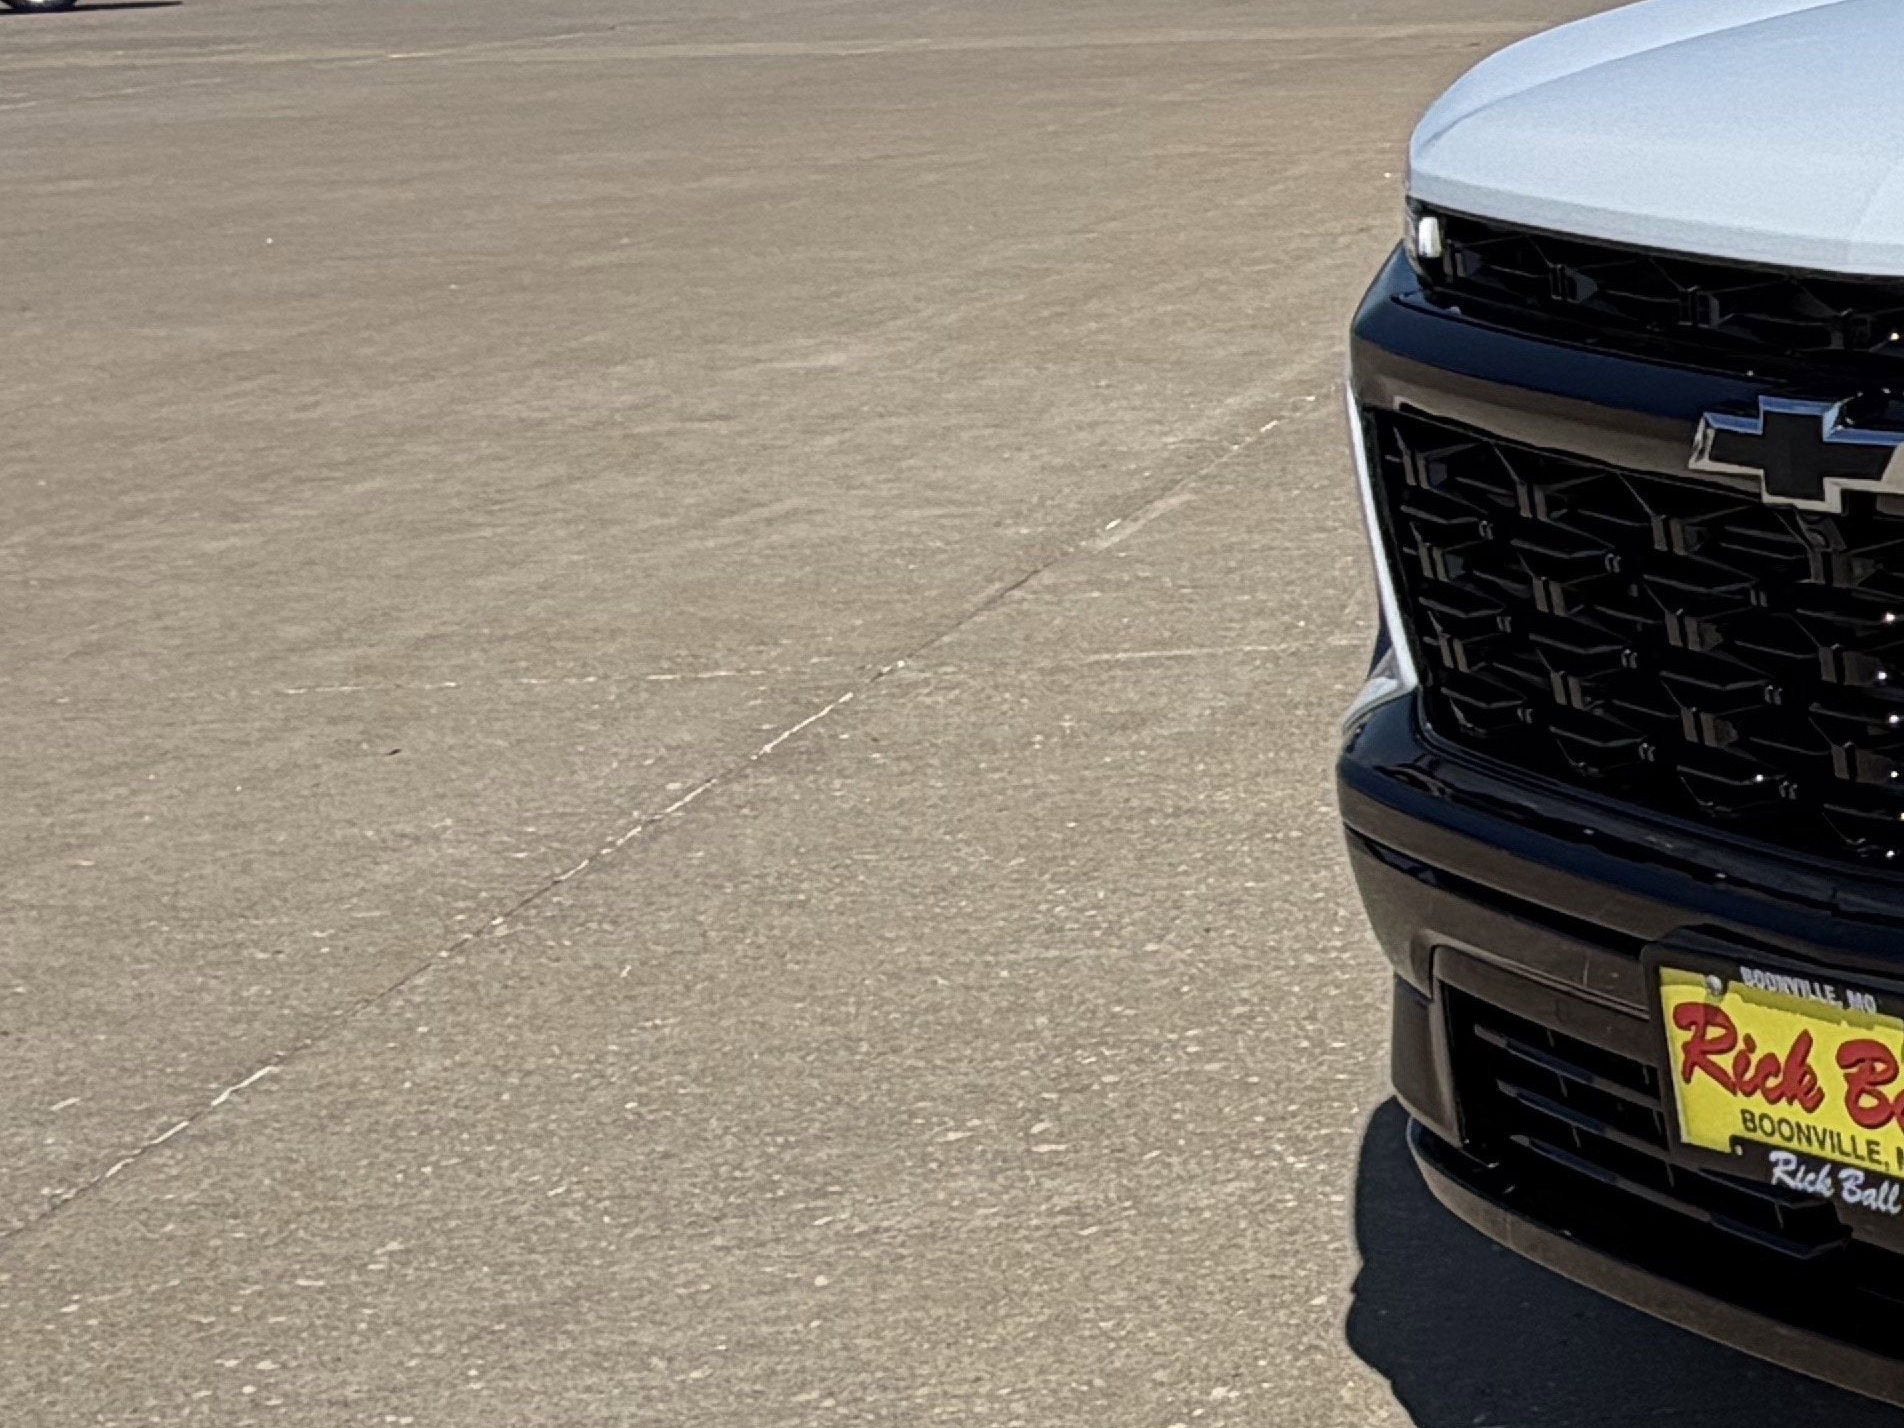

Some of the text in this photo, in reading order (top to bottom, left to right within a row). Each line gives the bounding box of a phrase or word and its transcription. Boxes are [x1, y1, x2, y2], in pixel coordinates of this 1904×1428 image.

[1740, 966, 1877, 1014] BOONVILLE, MO
[1673, 1002, 1825, 1113] Rick
[1740, 1109, 1891, 1172] BOONVILLE,
[1769, 1150, 1903, 1215] Rick Ball
